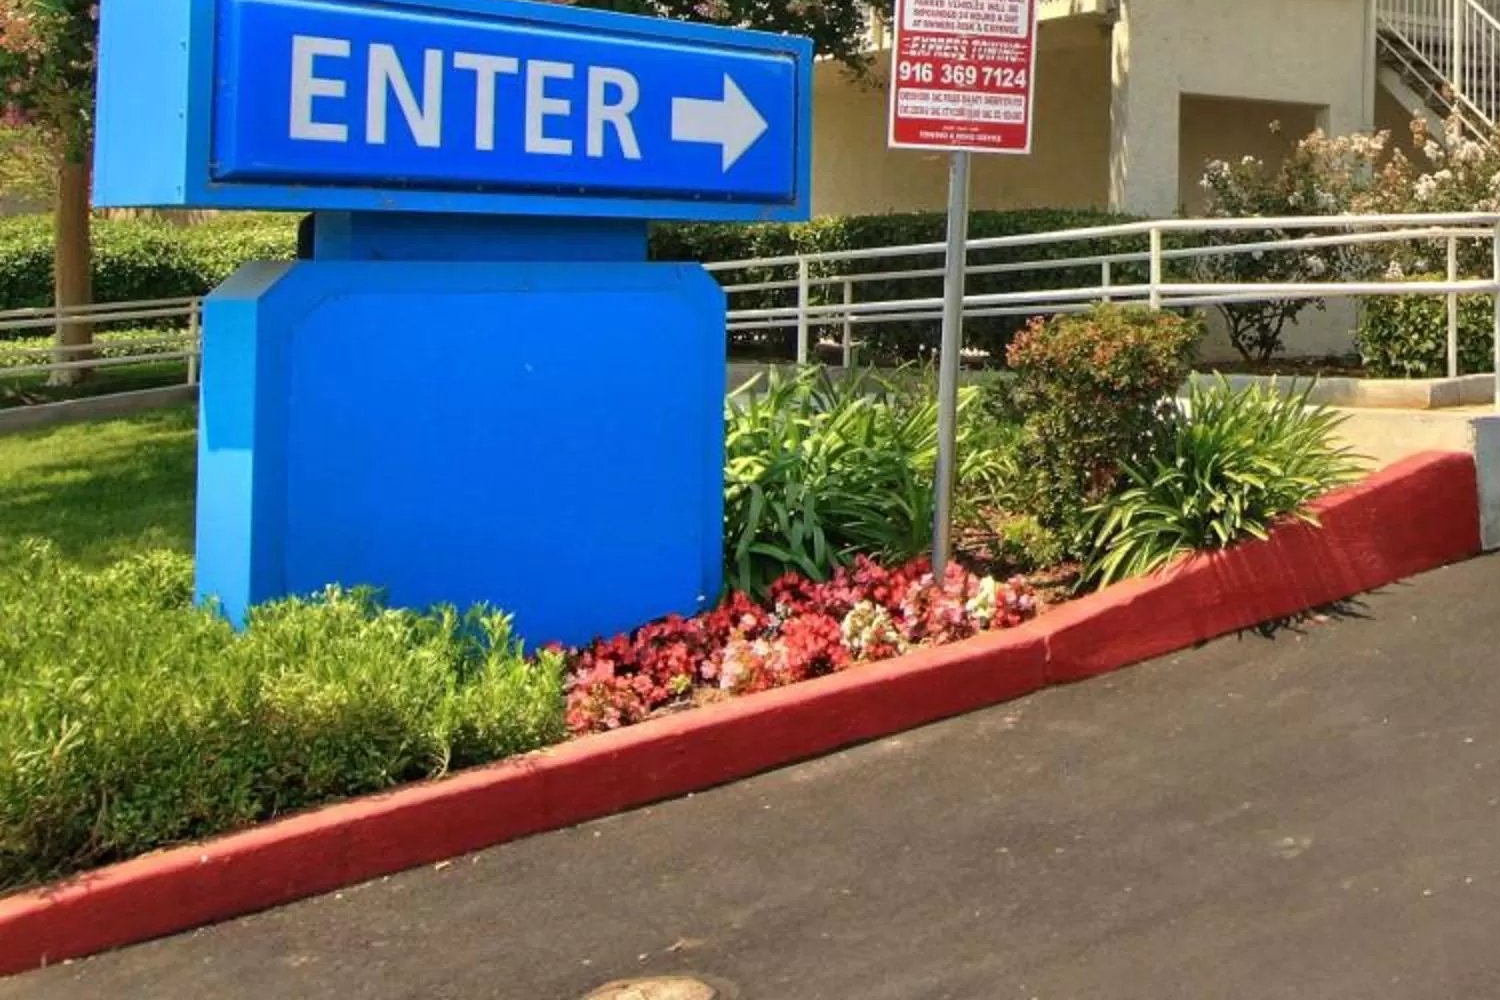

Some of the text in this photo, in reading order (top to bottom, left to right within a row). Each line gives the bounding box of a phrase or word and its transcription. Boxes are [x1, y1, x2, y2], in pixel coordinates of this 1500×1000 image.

[289, 35, 642, 160] ENTER
[899, 61, 1026, 89] 916 369 7124
